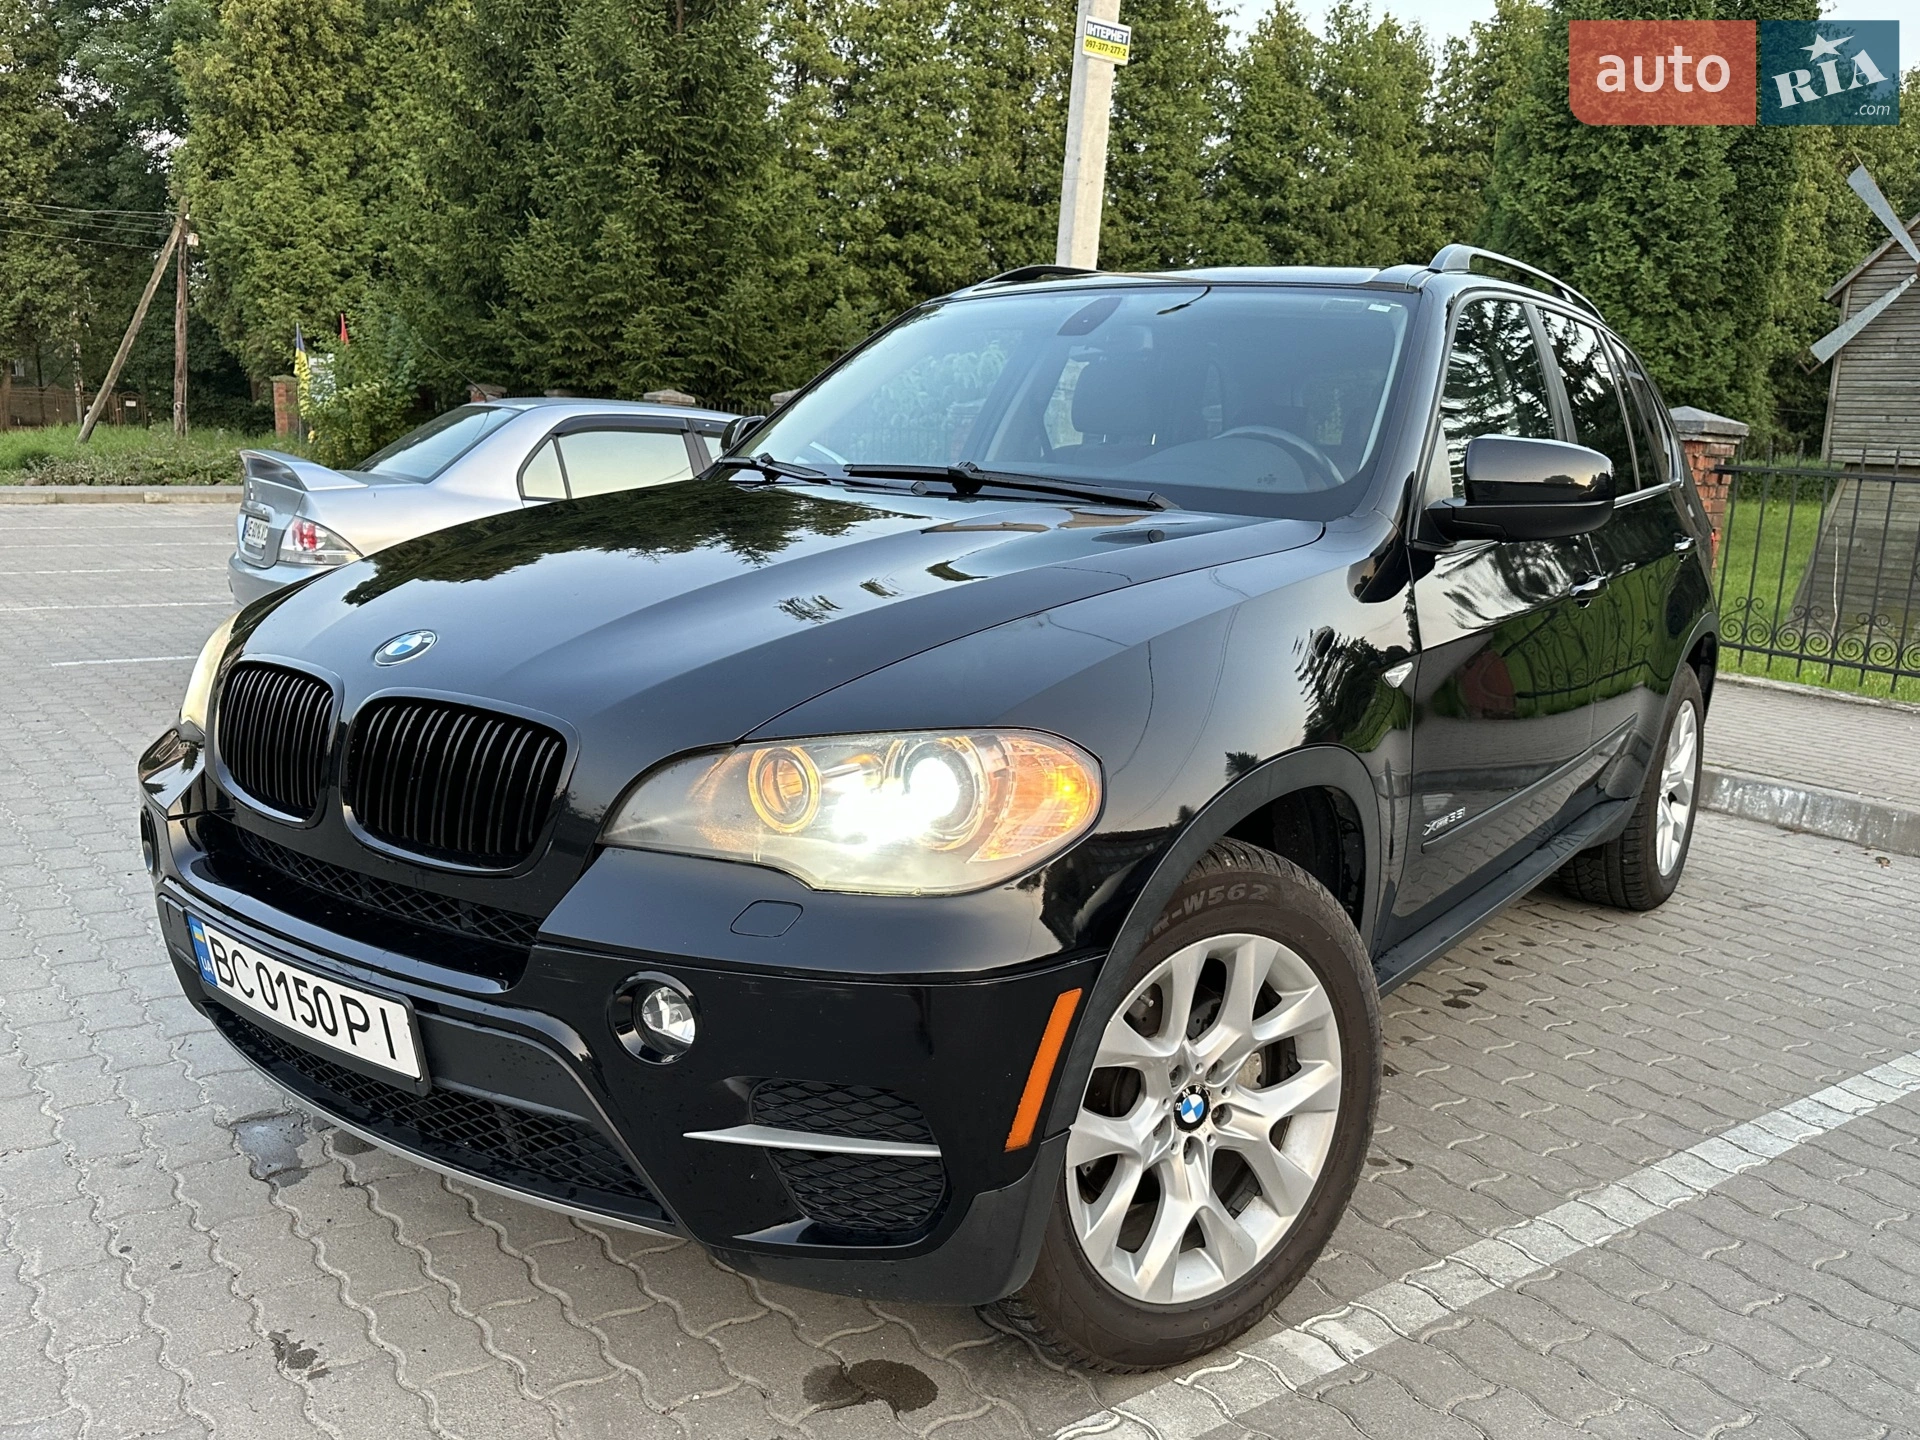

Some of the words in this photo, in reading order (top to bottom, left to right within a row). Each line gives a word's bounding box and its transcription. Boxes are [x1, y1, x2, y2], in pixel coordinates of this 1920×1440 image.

[1087, 23, 1129, 45] ІНТЕРНЕТ
[1085, 39, 1127, 56] 097-377-277-2
[200, 957, 214, 975] UA
